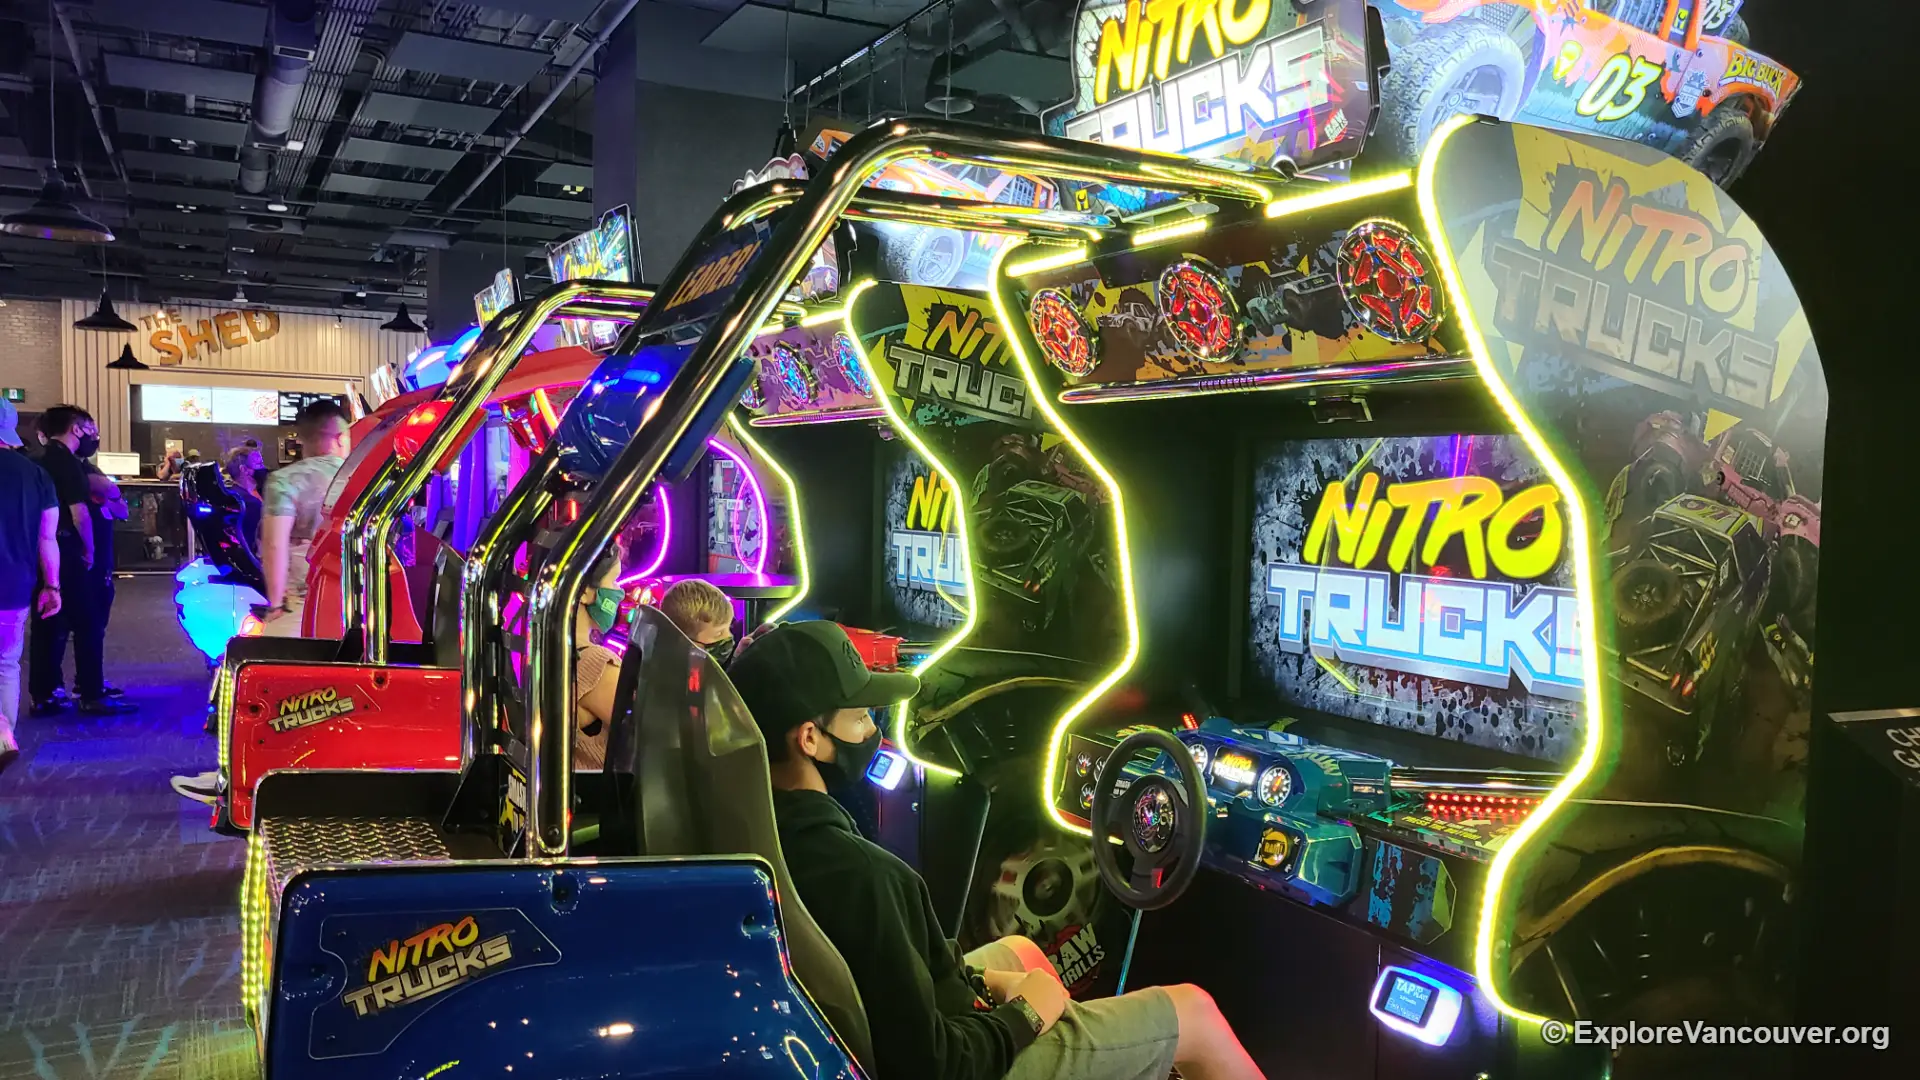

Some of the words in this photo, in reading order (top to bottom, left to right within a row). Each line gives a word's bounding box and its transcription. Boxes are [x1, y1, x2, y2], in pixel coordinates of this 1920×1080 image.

[1577, 53, 1665, 122] 03
[1720, 50, 1757, 79] BIG
[1755, 62, 1784, 100] BUCK
[1547, 181, 1747, 313] NITRO
[139, 308, 182, 331] THE
[150, 310, 280, 366] SHED
[926, 311, 1012, 366] NIT
[1491, 244, 1775, 410] TRUCKS
[889, 346, 1034, 420] TRUC
[1303, 472, 1562, 579] NITRO
[268, 697, 354, 733] TRUCKS
[280, 686, 337, 716] NITRO
[344, 935, 513, 1016] TRUCKS
[368, 916, 479, 982] NITRO
[1396, 977, 1416, 995] TAP
